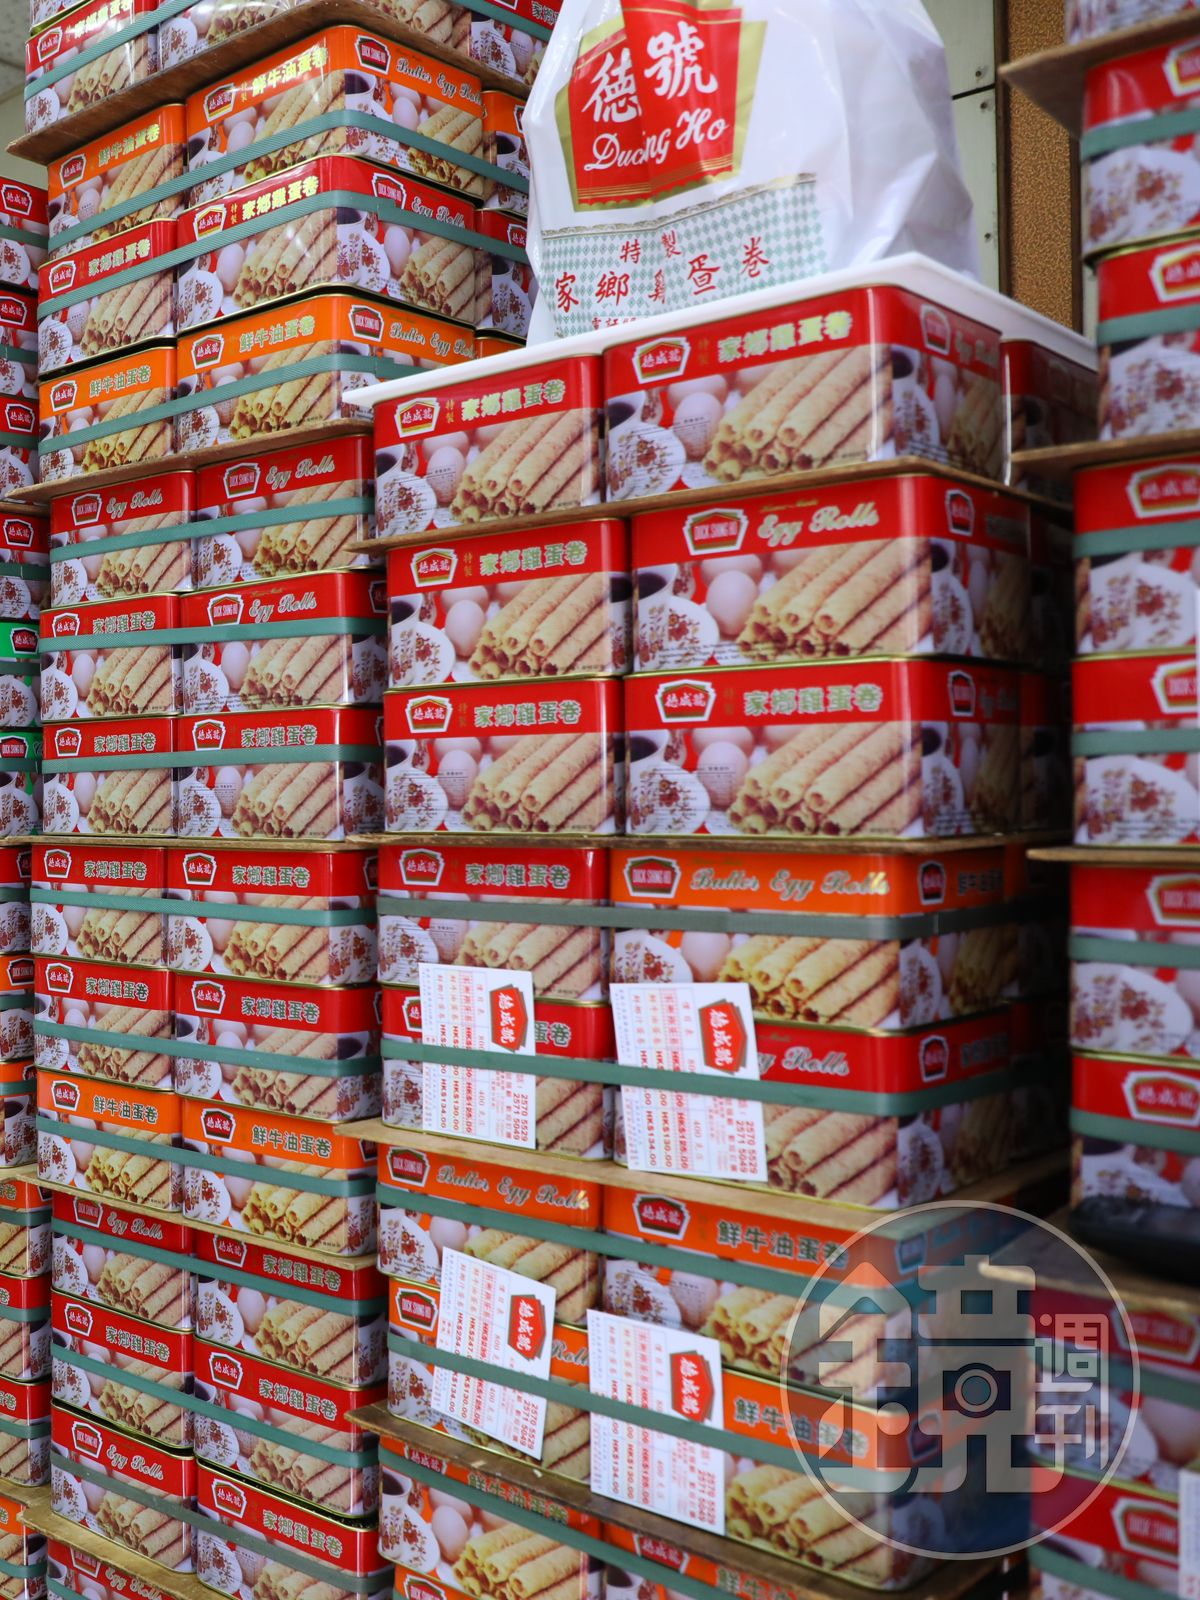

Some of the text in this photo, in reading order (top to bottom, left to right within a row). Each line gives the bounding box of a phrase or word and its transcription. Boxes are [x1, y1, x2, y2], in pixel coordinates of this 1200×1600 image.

[252, 46, 328, 97] 鮮牛油蛋卷
[397, 58, 432, 83] Butter
[437, 74, 456, 98] Egg
[581, 21, 718, 123] 德號
[676, 108, 729, 149] Ho
[620, 230, 681, 265] 特製
[240, 316, 315, 352] 鮮牛油蛋卷
[718, 311, 853, 363] 家鄉雞蛋卷
[90, 366, 151, 397] 鮮牛油蛋卷
[461, 379, 566, 421] 家鄉雞蛋卷
[266, 455, 335, 489] Egg Rolls
[106, 489, 163, 519] Egg Rolls
[757, 501, 879, 546] Egg Rolls
[479, 541, 587, 576] 家鄉雞蛋卷
[249, 592, 317, 624] Egg Rolls
[474, 701, 581, 728] 家鄉雞蛋卷
[744, 684, 883, 717] 家鄉雞蛋卷
[94, 733, 156, 753] 家鄉雞蛋卷
[241, 724, 318, 748] 家鄉雞蛋卷
[84, 860, 147, 881] 家鄉雞蛋卷
[232, 865, 310, 888] 家鄉雞蛋卷
[465, 864, 570, 889] 家鄉雞蛋卷
[690, 868, 889, 901] Butter Egg Rolls
[86, 977, 149, 1002] 家鄉雞蛋卷
[242, 996, 320, 1024] 家鄉雞蛋卷
[498, 992, 515, 1044] 德成號
[710, 1009, 734, 1067] 德成號
[783, 1046, 850, 1076] Rolls
[93, 1095, 159, 1124] 鮮牛油蛋卷
[252, 1126, 331, 1158] 鮮牛油蛋卷
[647, 1111, 656, 1166] HK$134.00
[662, 1112, 672, 1167] HK$130.00
[736, 1121, 746, 1145] 2571
[746, 1121, 756, 1145] 2570
[437, 1165, 590, 1209] Butter Egg Rolls
[106, 1211, 163, 1241] Egg Rolls
[717, 1219, 848, 1270] 鮮牛油蛋卷
[263, 1255, 342, 1292] 家鄉雞蛋卷
[402, 1298, 412, 1312] DUCK
[412, 1301, 424, 1316] SHING
[516, 1300, 535, 1351] 德成號
[106, 1326, 170, 1363] 家鄉雞蛋卷
[259, 1379, 338, 1421] 家鄉雞蛋卷
[679, 1356, 700, 1415] 德成號
[106, 1444, 164, 1481] Egg Rolls
[263, 1509, 343, 1559] 家鄉雞蛋卷
